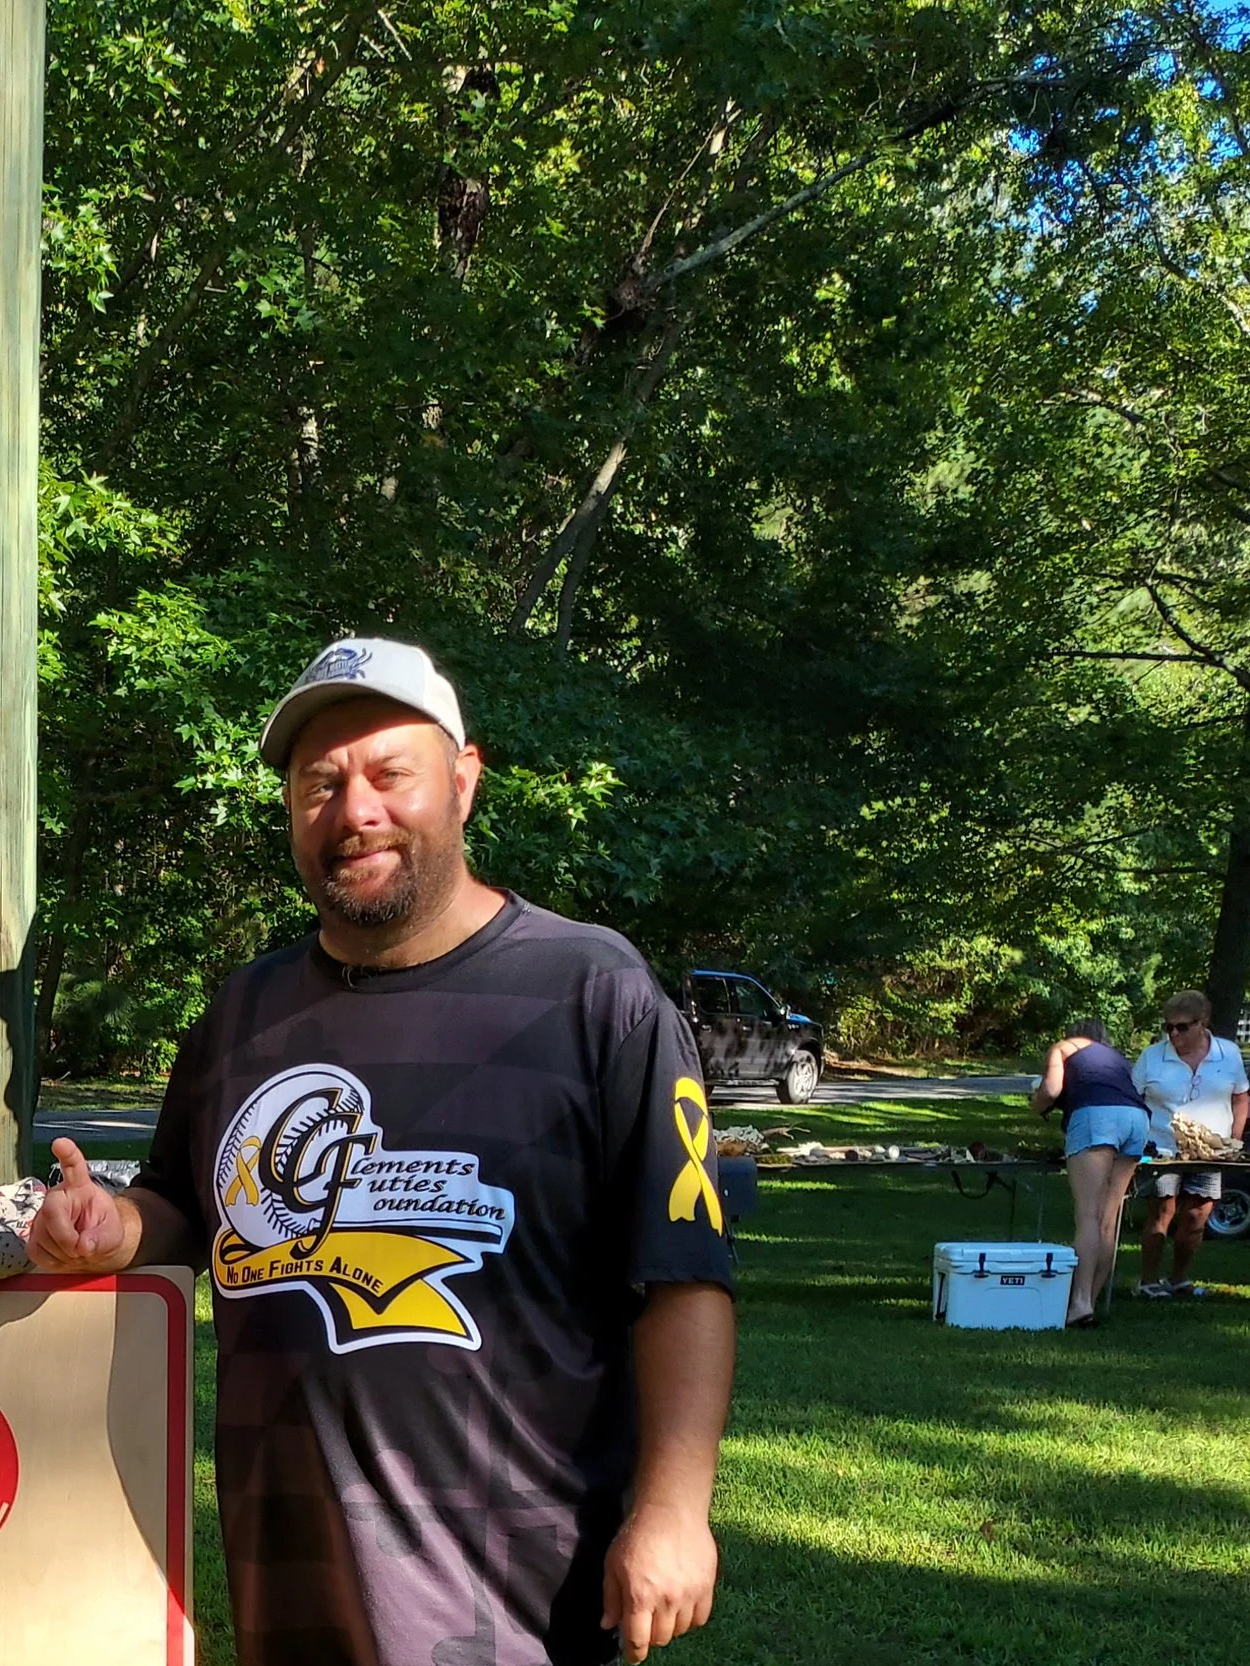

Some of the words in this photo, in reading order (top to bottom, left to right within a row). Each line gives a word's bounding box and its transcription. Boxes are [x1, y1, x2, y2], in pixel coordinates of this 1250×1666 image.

[268, 1260, 324, 1278] FIGHTS
[329, 1256, 384, 1294] ALONE
[1002, 1277, 1024, 1285] YETI
